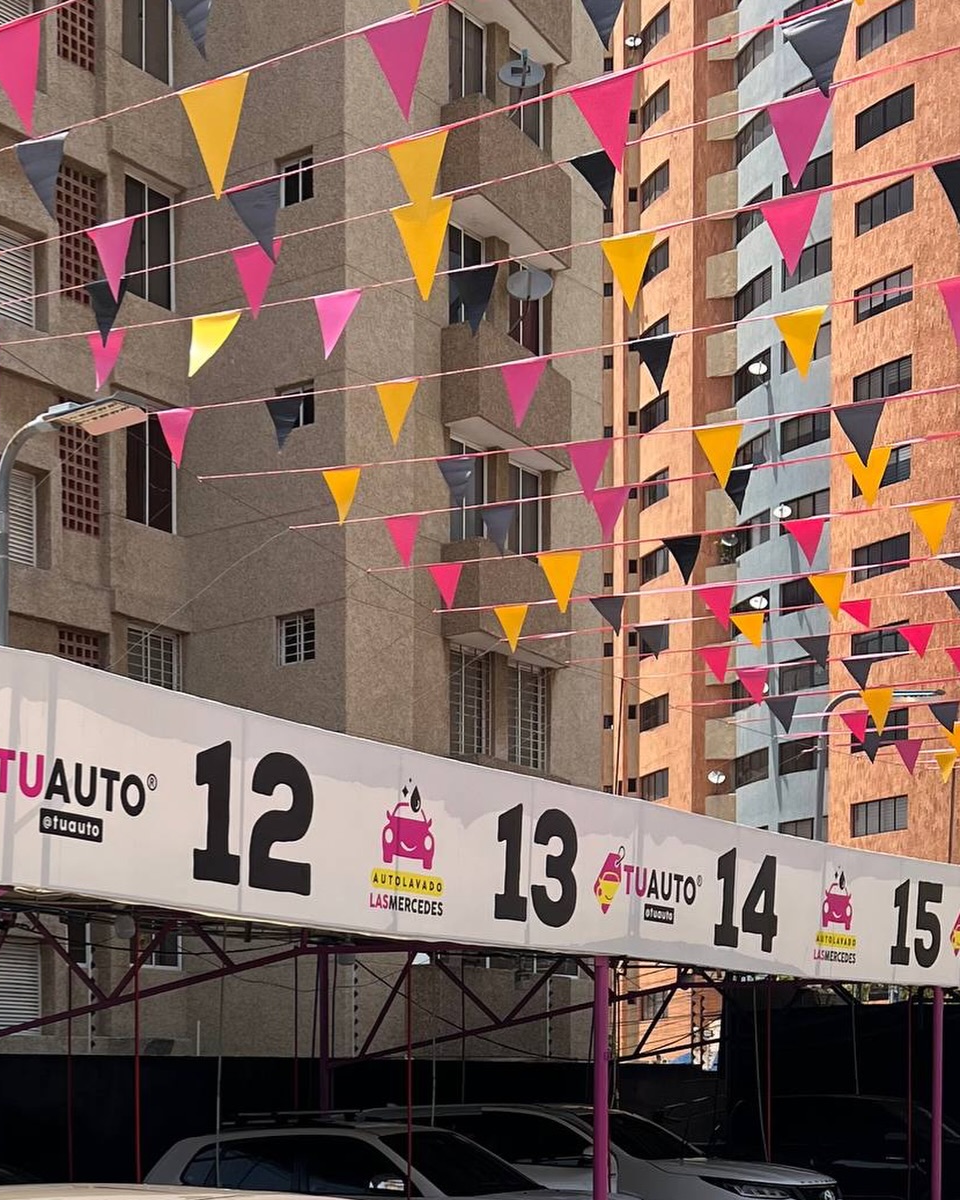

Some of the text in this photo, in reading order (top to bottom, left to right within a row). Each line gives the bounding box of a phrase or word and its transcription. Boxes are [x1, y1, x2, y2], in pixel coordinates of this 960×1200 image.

[42, 815, 100, 837] @tuauto
[193, 741, 313, 896] 12
[494, 804, 577, 927] 13
[373, 872, 443, 893] AUTOLAVADO
[714, 848, 778, 953] 14
[890, 878, 943, 968] 15
